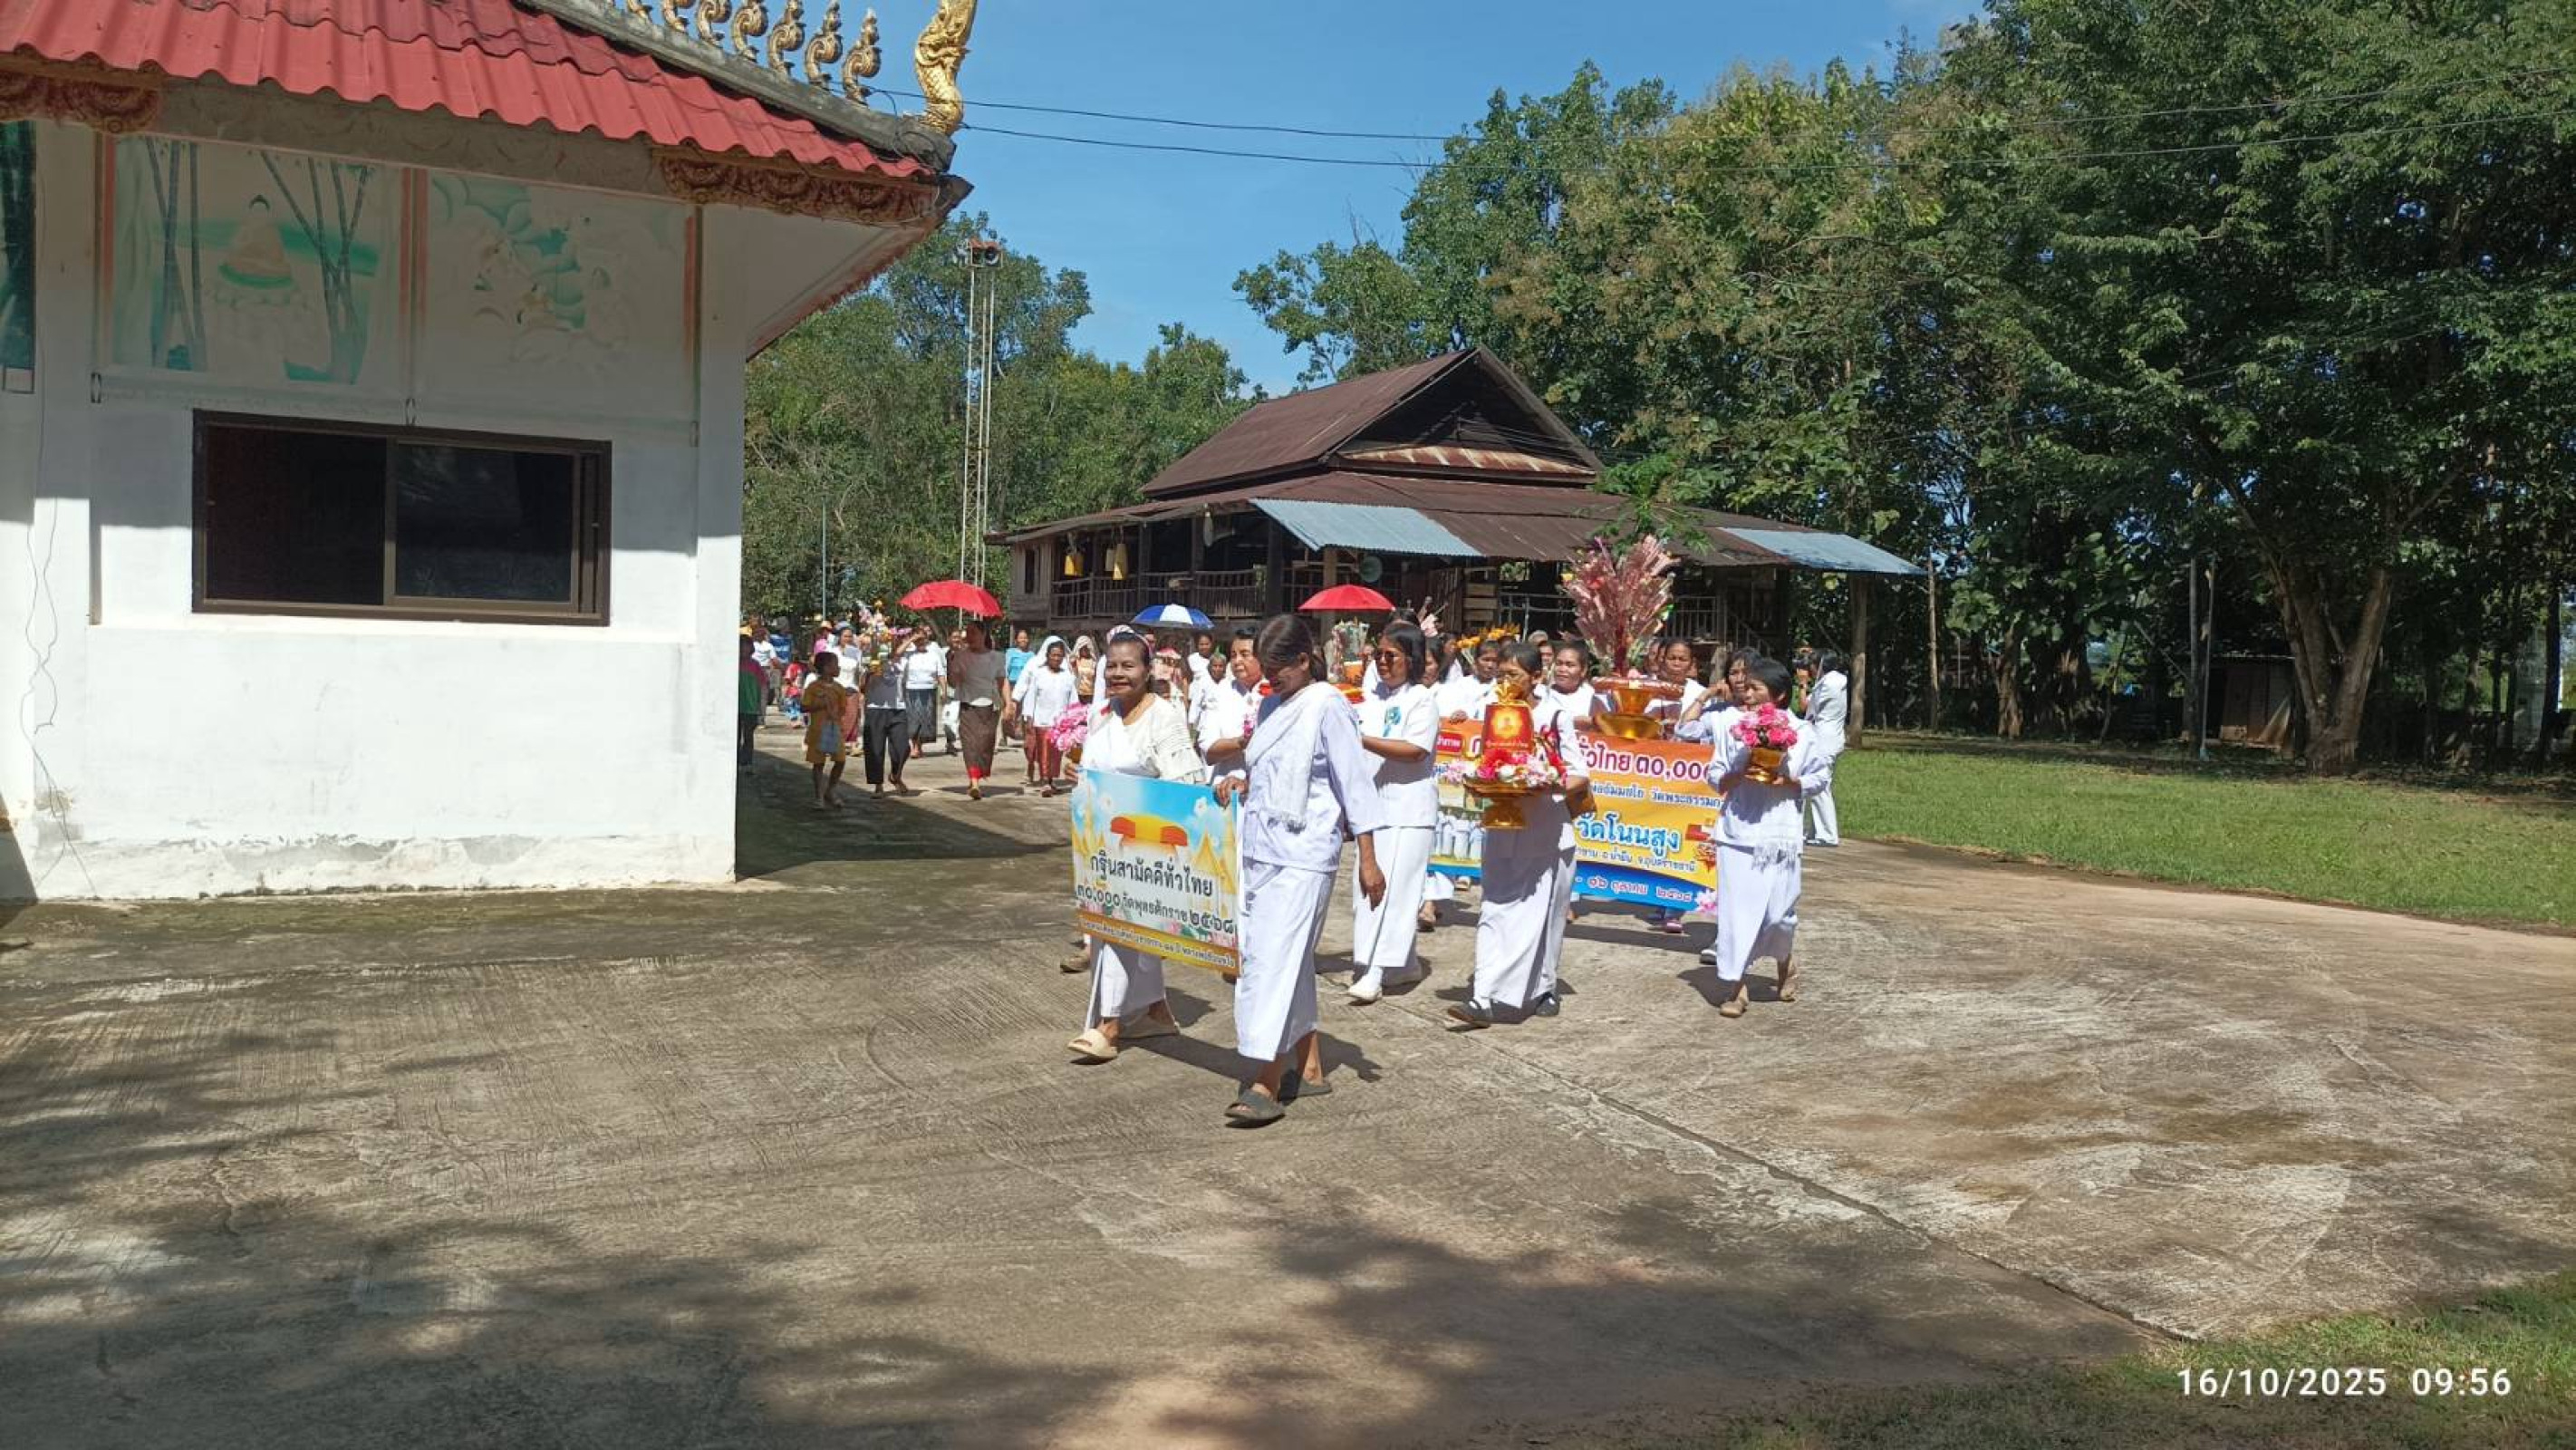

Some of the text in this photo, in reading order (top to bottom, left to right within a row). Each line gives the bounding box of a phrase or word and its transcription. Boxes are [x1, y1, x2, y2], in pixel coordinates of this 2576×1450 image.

[1575, 814, 1681, 856] วัดโนนสูง
[1090, 848, 1213, 898] กฐินสามัคคีทั่วไทย
